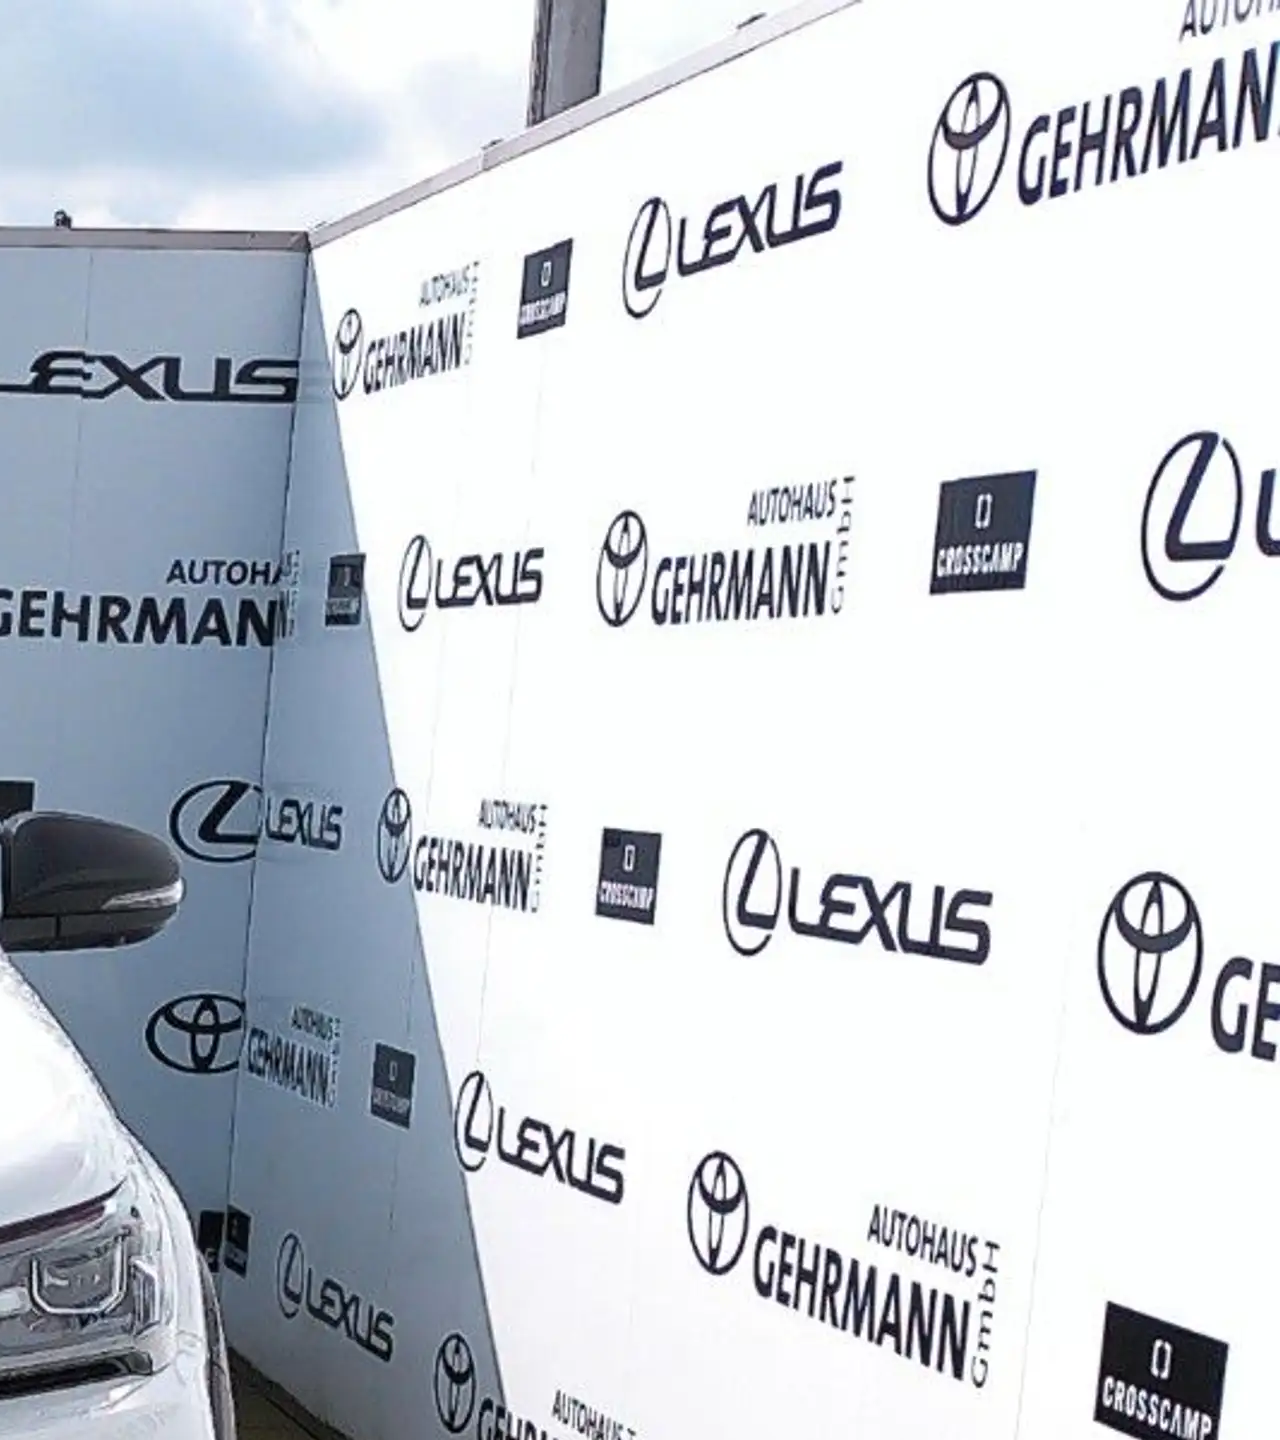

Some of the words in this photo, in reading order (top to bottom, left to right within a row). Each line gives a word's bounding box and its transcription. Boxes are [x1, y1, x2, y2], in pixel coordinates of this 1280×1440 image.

[677, 161, 842, 277] LEXUS
[363, 312, 465, 394] GEHRMANN
[748, 480, 837, 526] AUTOHAUS
[436, 548, 544, 607] LEXUS
[652, 541, 830, 625] GEHRMANN
[936, 541, 1024, 577] CROSSCAMP
[266, 798, 344, 850] LEXUS
[414, 834, 531, 912] GEHRMANN
[788, 868, 993, 965] LEXUS
[495, 1106, 626, 1204] LEXUS
[867, 1204, 978, 1277] AUTOHAUS
[306, 1268, 394, 1361] LEXUS
[754, 1226, 970, 1381] GEHRMANN
[971, 1240, 1000, 1389] GmbH
